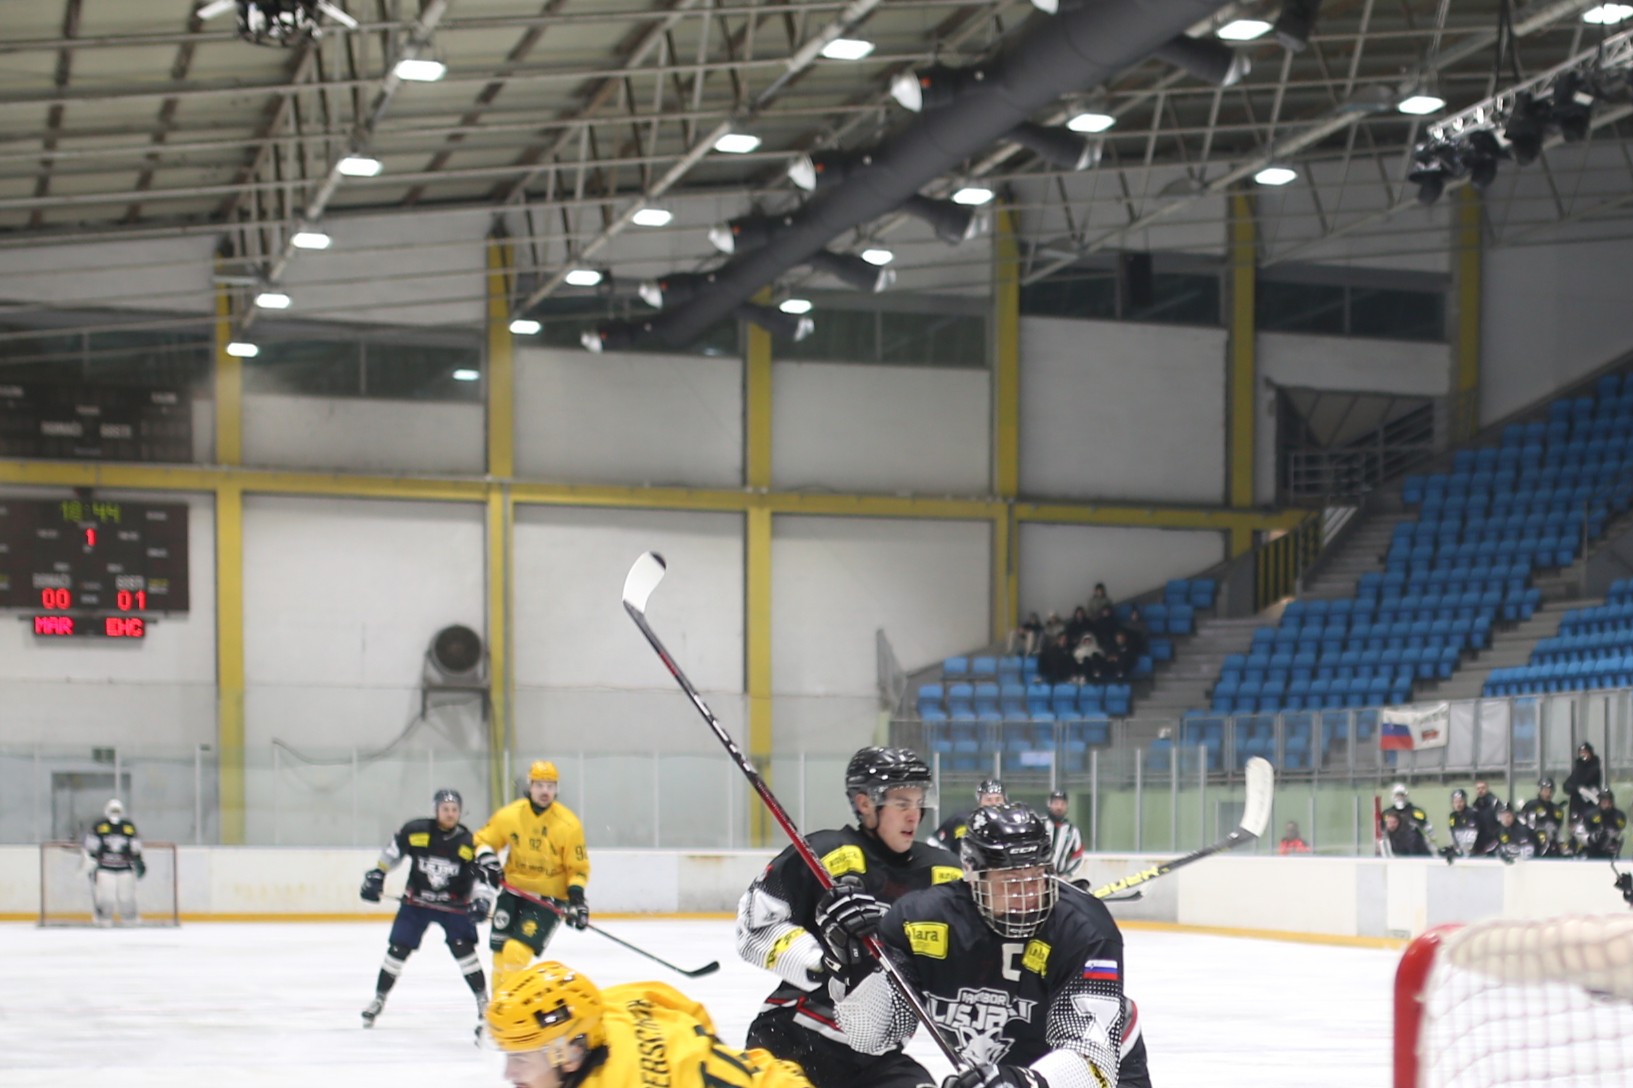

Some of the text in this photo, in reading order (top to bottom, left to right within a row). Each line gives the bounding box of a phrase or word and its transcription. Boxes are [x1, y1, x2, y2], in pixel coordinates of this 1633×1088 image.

[86, 528, 96, 547] 1
[41, 587, 147, 611] 00 01
[34, 616, 75, 635] MAR
[1009, 846, 1038, 855] CCM
[1002, 943, 1025, 982] C
